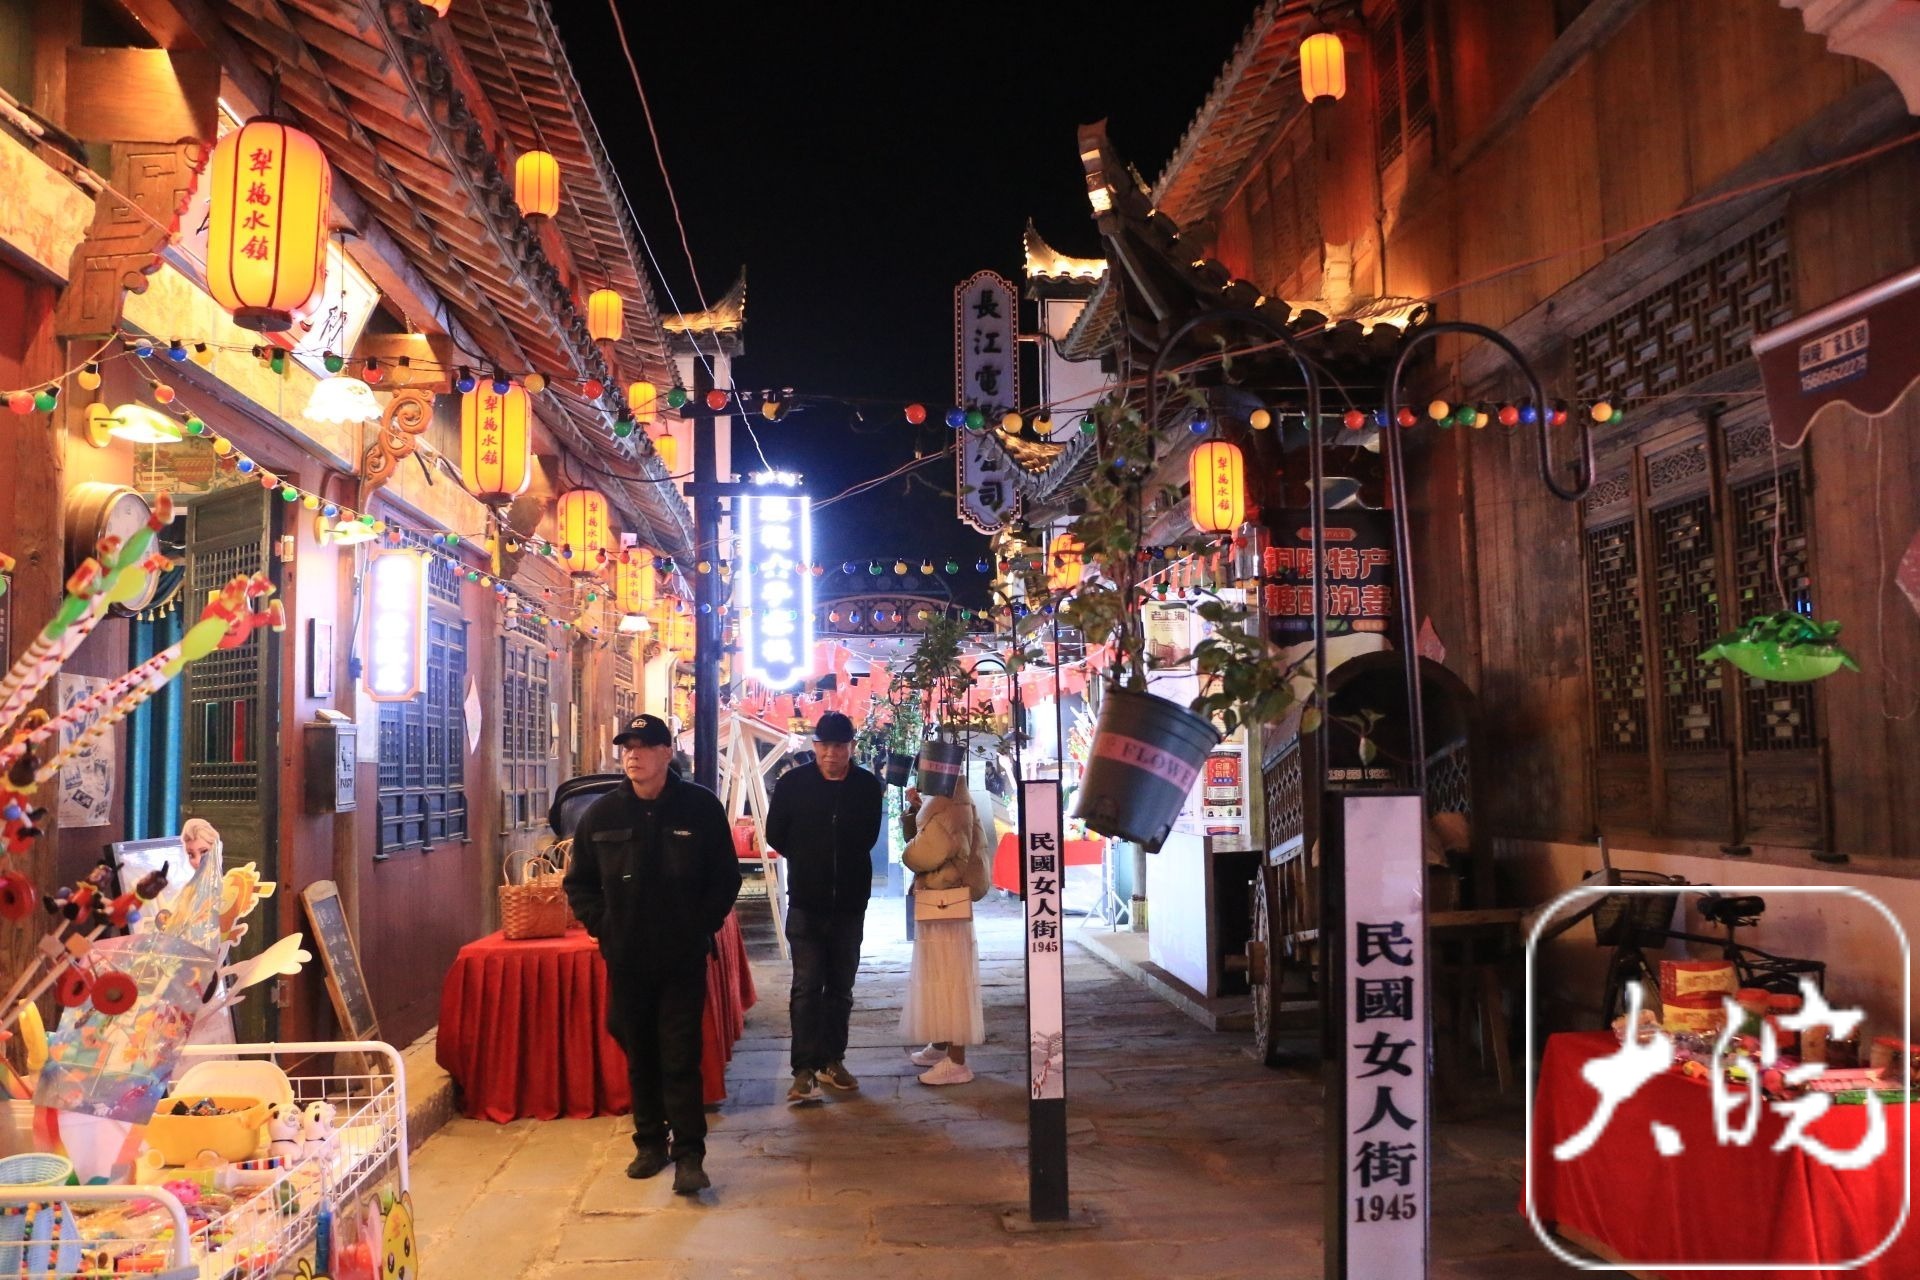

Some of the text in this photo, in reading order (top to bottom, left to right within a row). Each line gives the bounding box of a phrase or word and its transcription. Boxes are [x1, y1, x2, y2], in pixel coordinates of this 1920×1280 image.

[1030, 832, 1057, 939] 民國女人街
[1031, 941, 1058, 953] 1945
[1353, 921, 1417, 1188] 民國女人街
[1354, 1193, 1417, 1222] 1945
